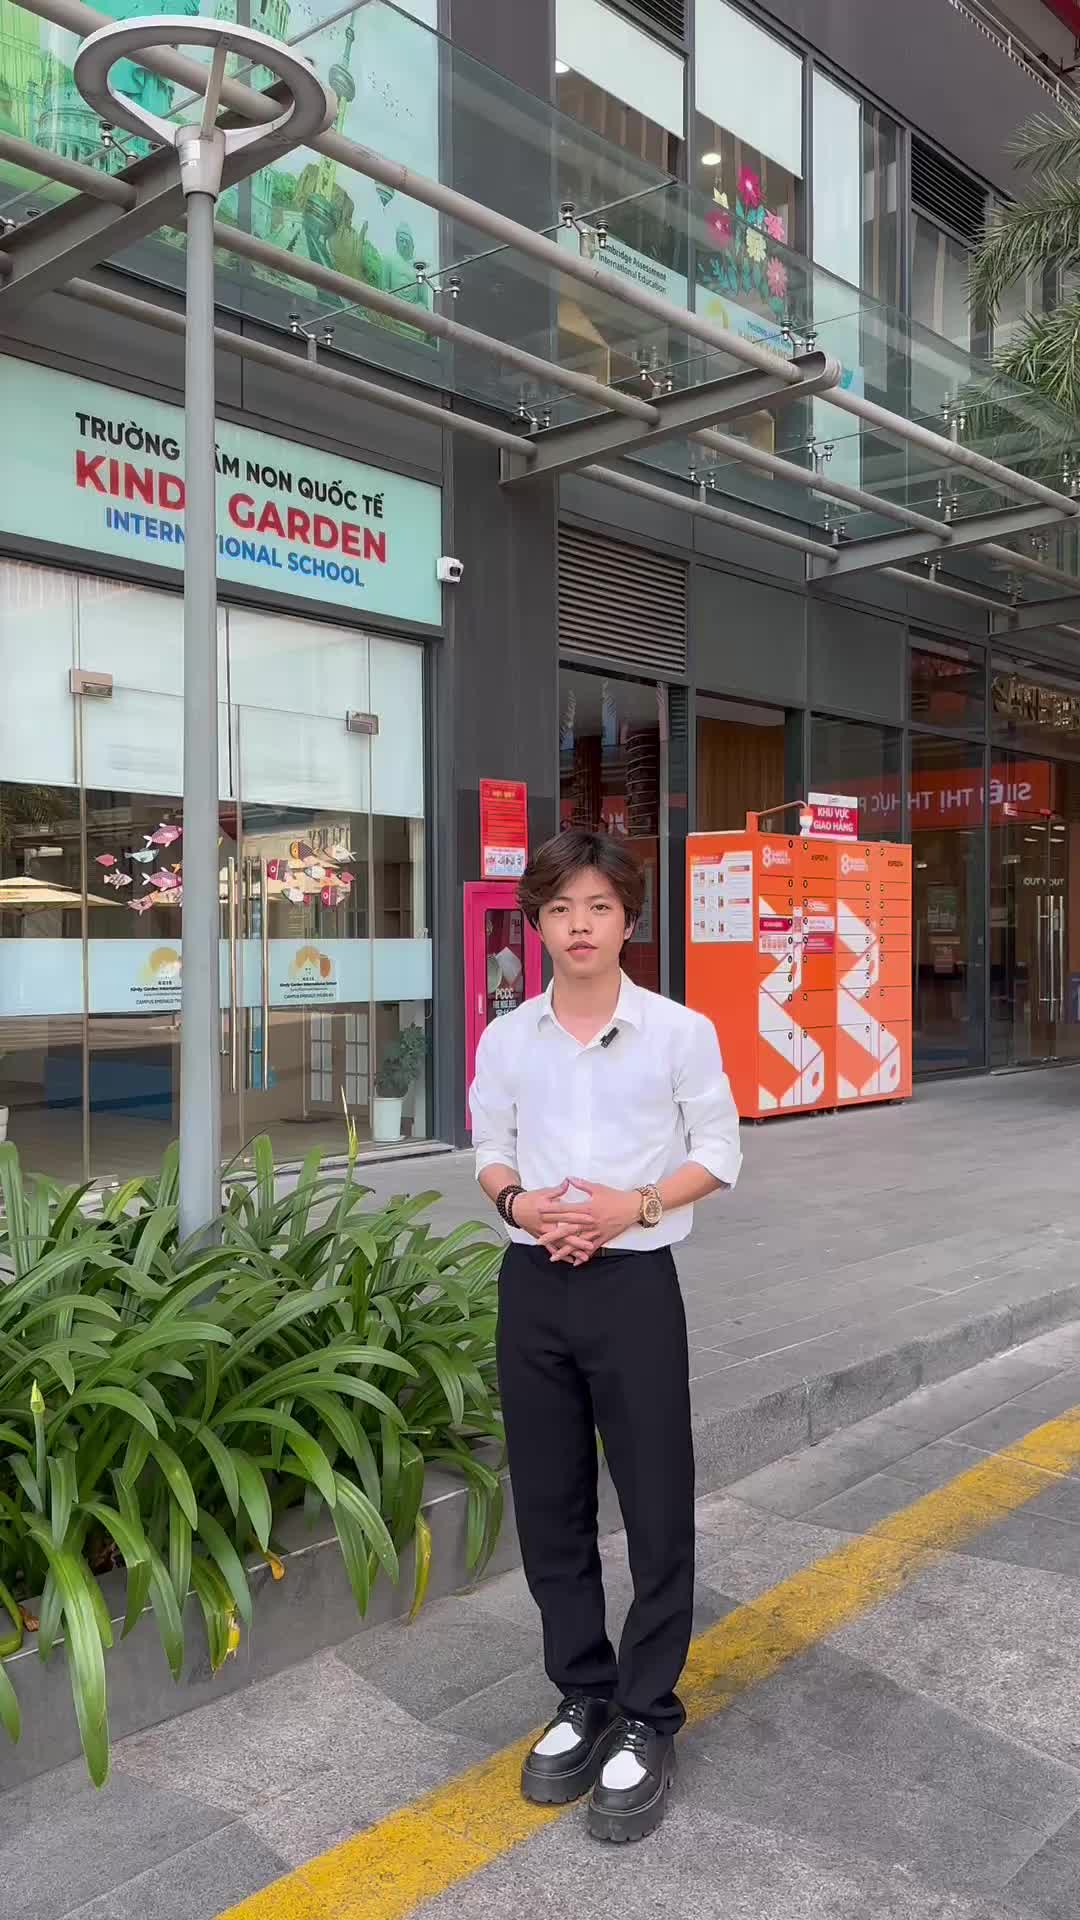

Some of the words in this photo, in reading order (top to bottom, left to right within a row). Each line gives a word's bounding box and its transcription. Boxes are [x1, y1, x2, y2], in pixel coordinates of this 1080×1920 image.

[75, 412, 180, 461] TRƯỜNG
[246, 461, 292, 493] NON
[297, 479, 358, 511] QUỐC
[362, 493, 385, 519] TẾ
[106, 507, 283, 569] INTERNIONAL
[287, 552, 365, 588] SCHOOL
[227, 492, 387, 564] GARDEN
[813, 820, 832, 831] GIAO
[817, 807, 834, 817] KHU
[834, 807, 850, 820] VỰC
